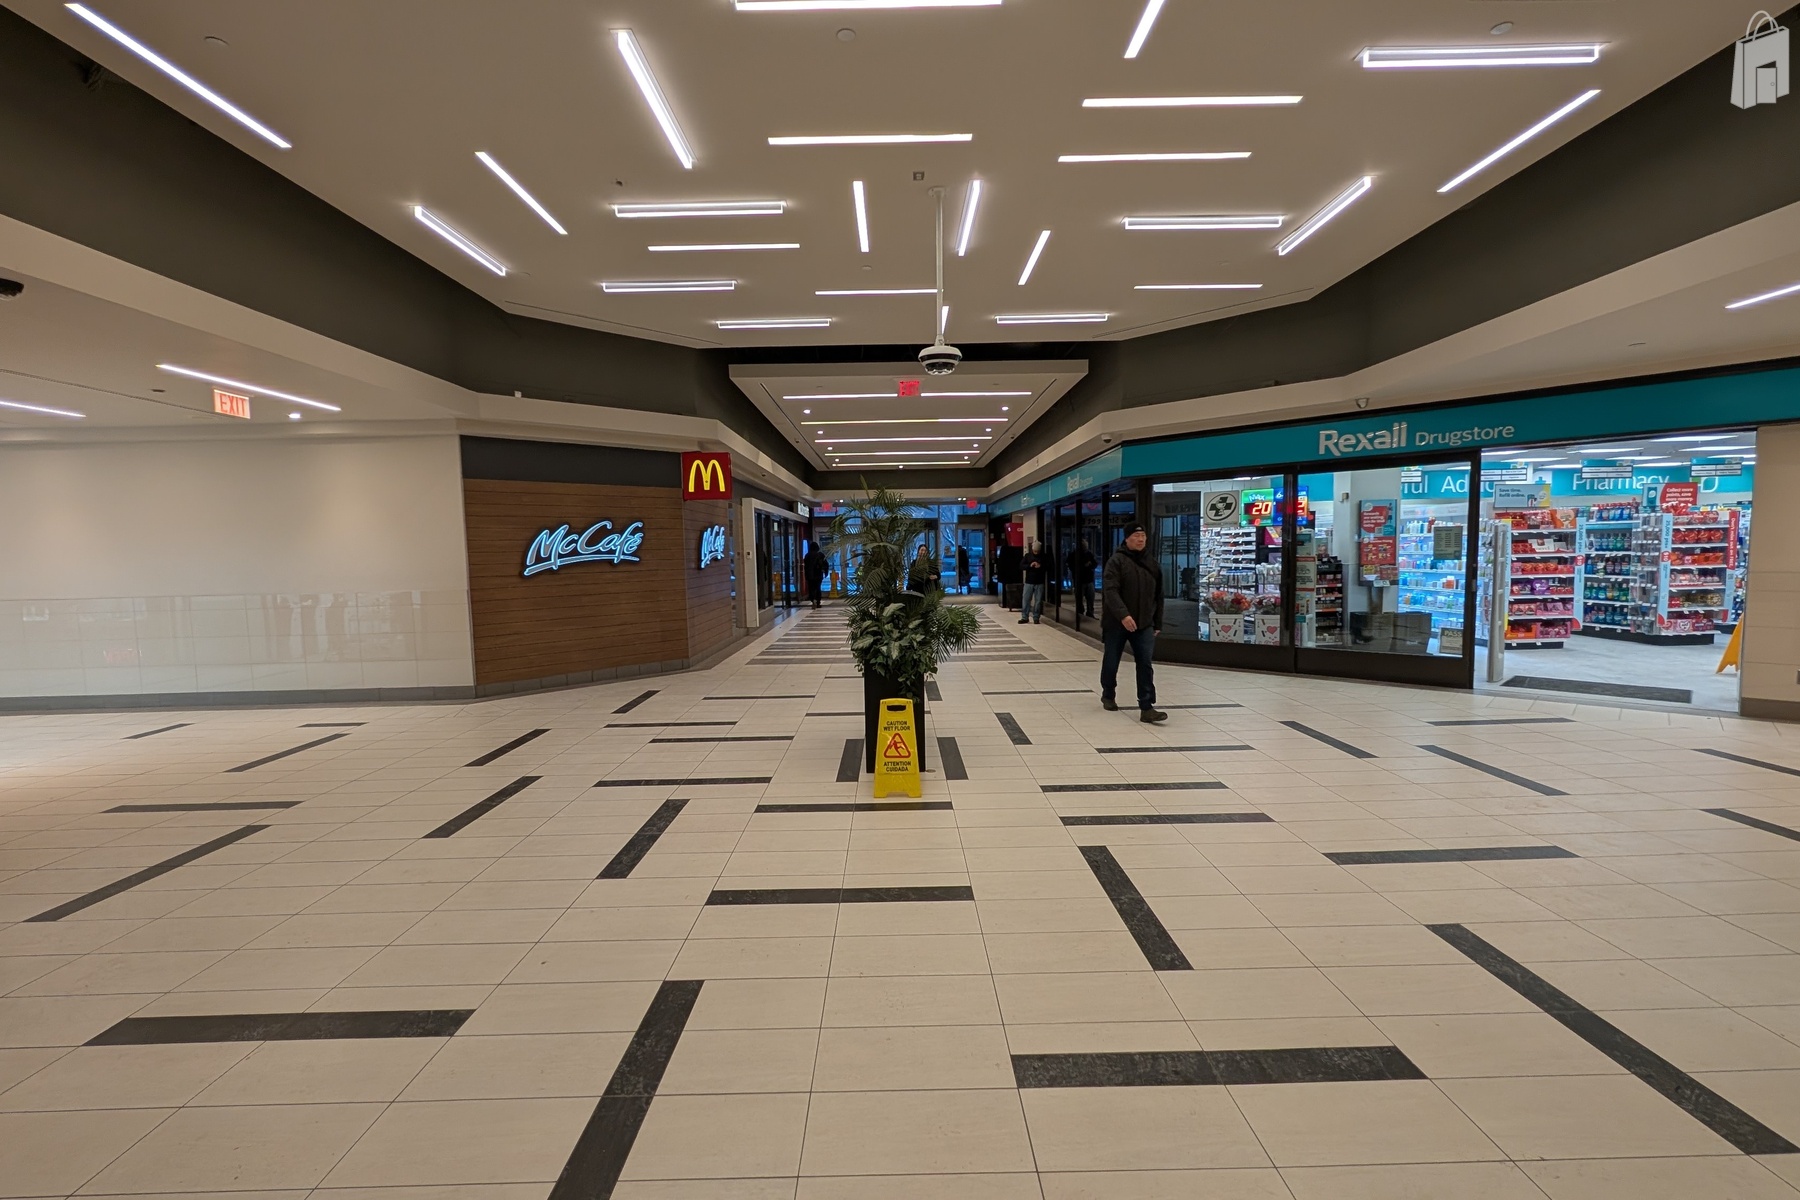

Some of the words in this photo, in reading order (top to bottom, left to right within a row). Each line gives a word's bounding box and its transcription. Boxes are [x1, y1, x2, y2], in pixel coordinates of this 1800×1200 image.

[220, 393, 246, 417] EXIT
[1318, 421, 1408, 456] Rexall
[1415, 425, 1515, 446] Drugstore
[1252, 502, 1272, 515] 20
[524, 520, 644, 576] McCafé
